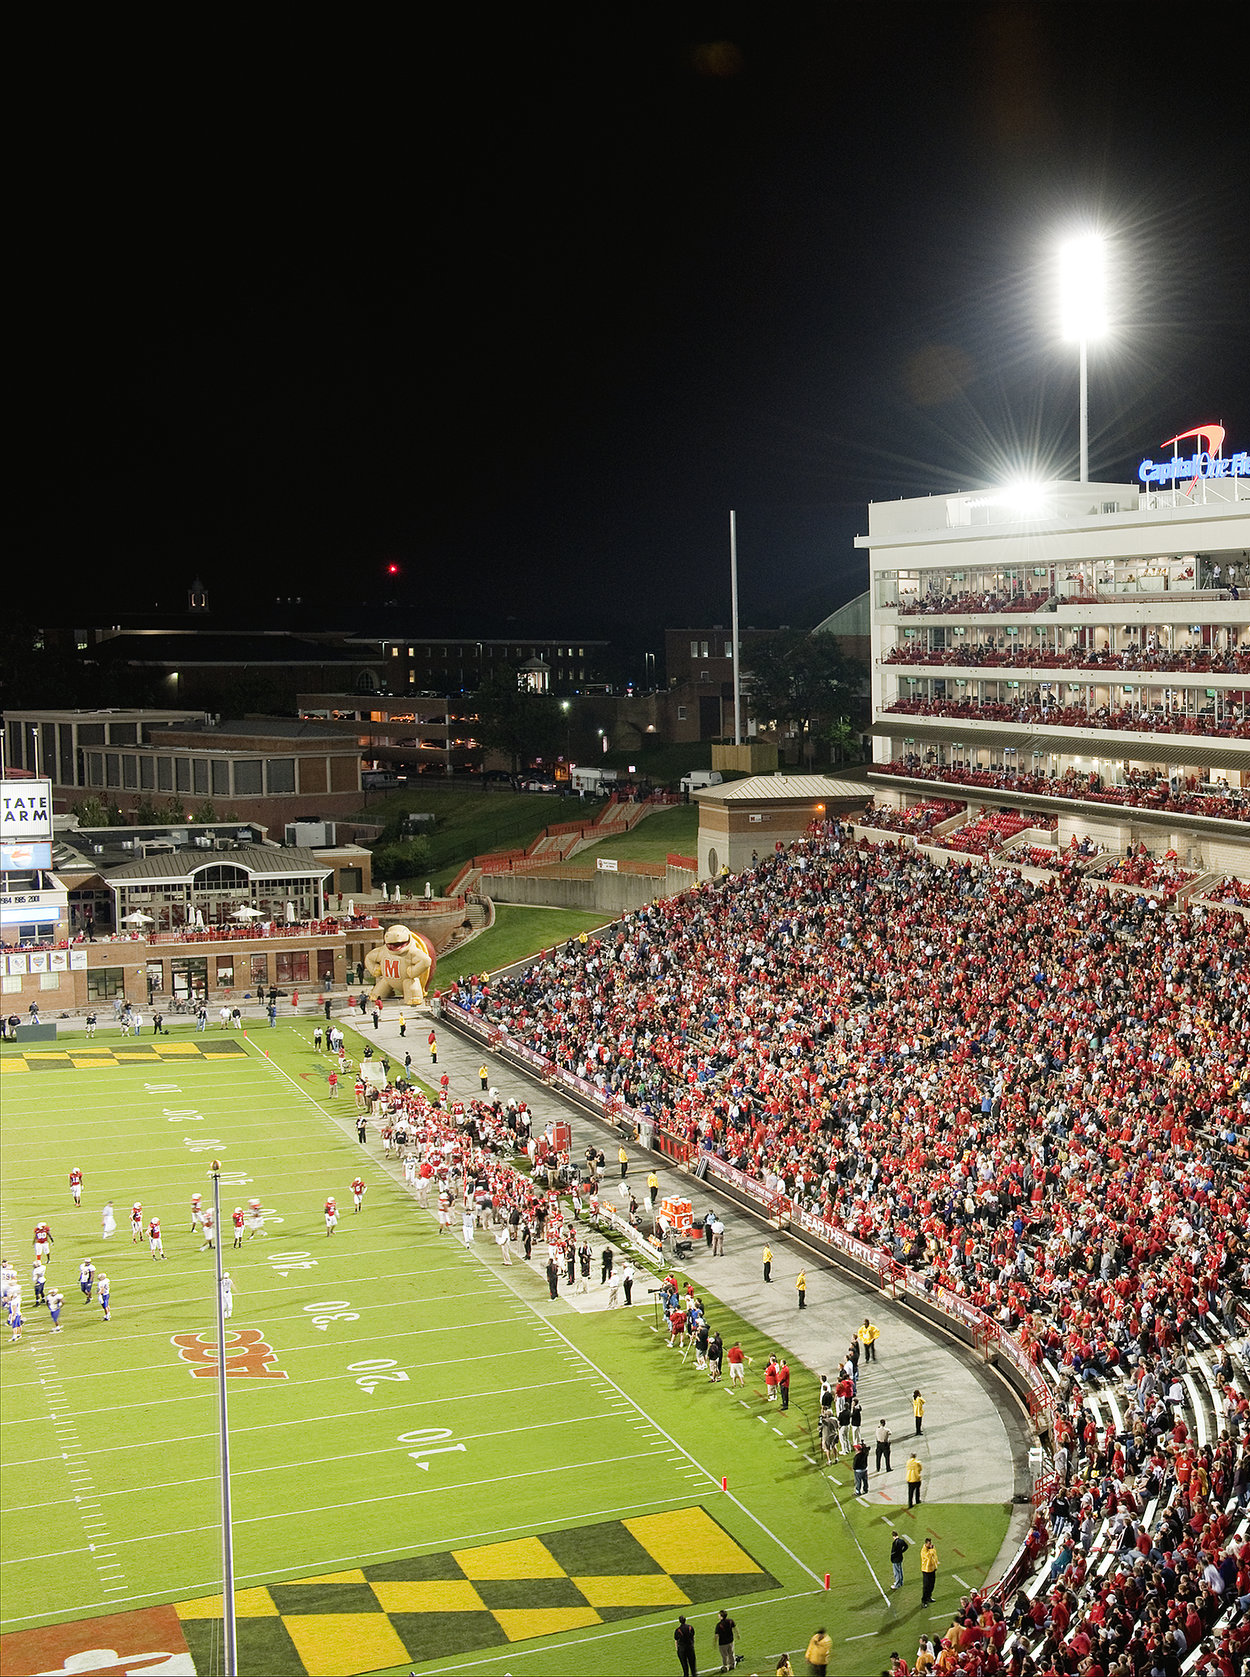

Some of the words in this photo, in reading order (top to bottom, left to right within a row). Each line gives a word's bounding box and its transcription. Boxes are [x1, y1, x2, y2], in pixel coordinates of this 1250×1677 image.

[3, 797, 47, 809] TATE
[4, 810, 48, 822] ARM
[383, 959, 401, 979] M
[162, 1109, 205, 1122] 20
[184, 1138, 227, 1152] 30
[801, 1210, 825, 1234] FEAR
[825, 1225, 844, 1246] THE
[843, 1236, 881, 1269] TURTLE
[267, 1251, 319, 1270] 40
[303, 1300, 361, 1326] 30
[170, 1328, 289, 1379] ACC
[346, 1359, 410, 1387] 20
[397, 1427, 468, 1459] 10
